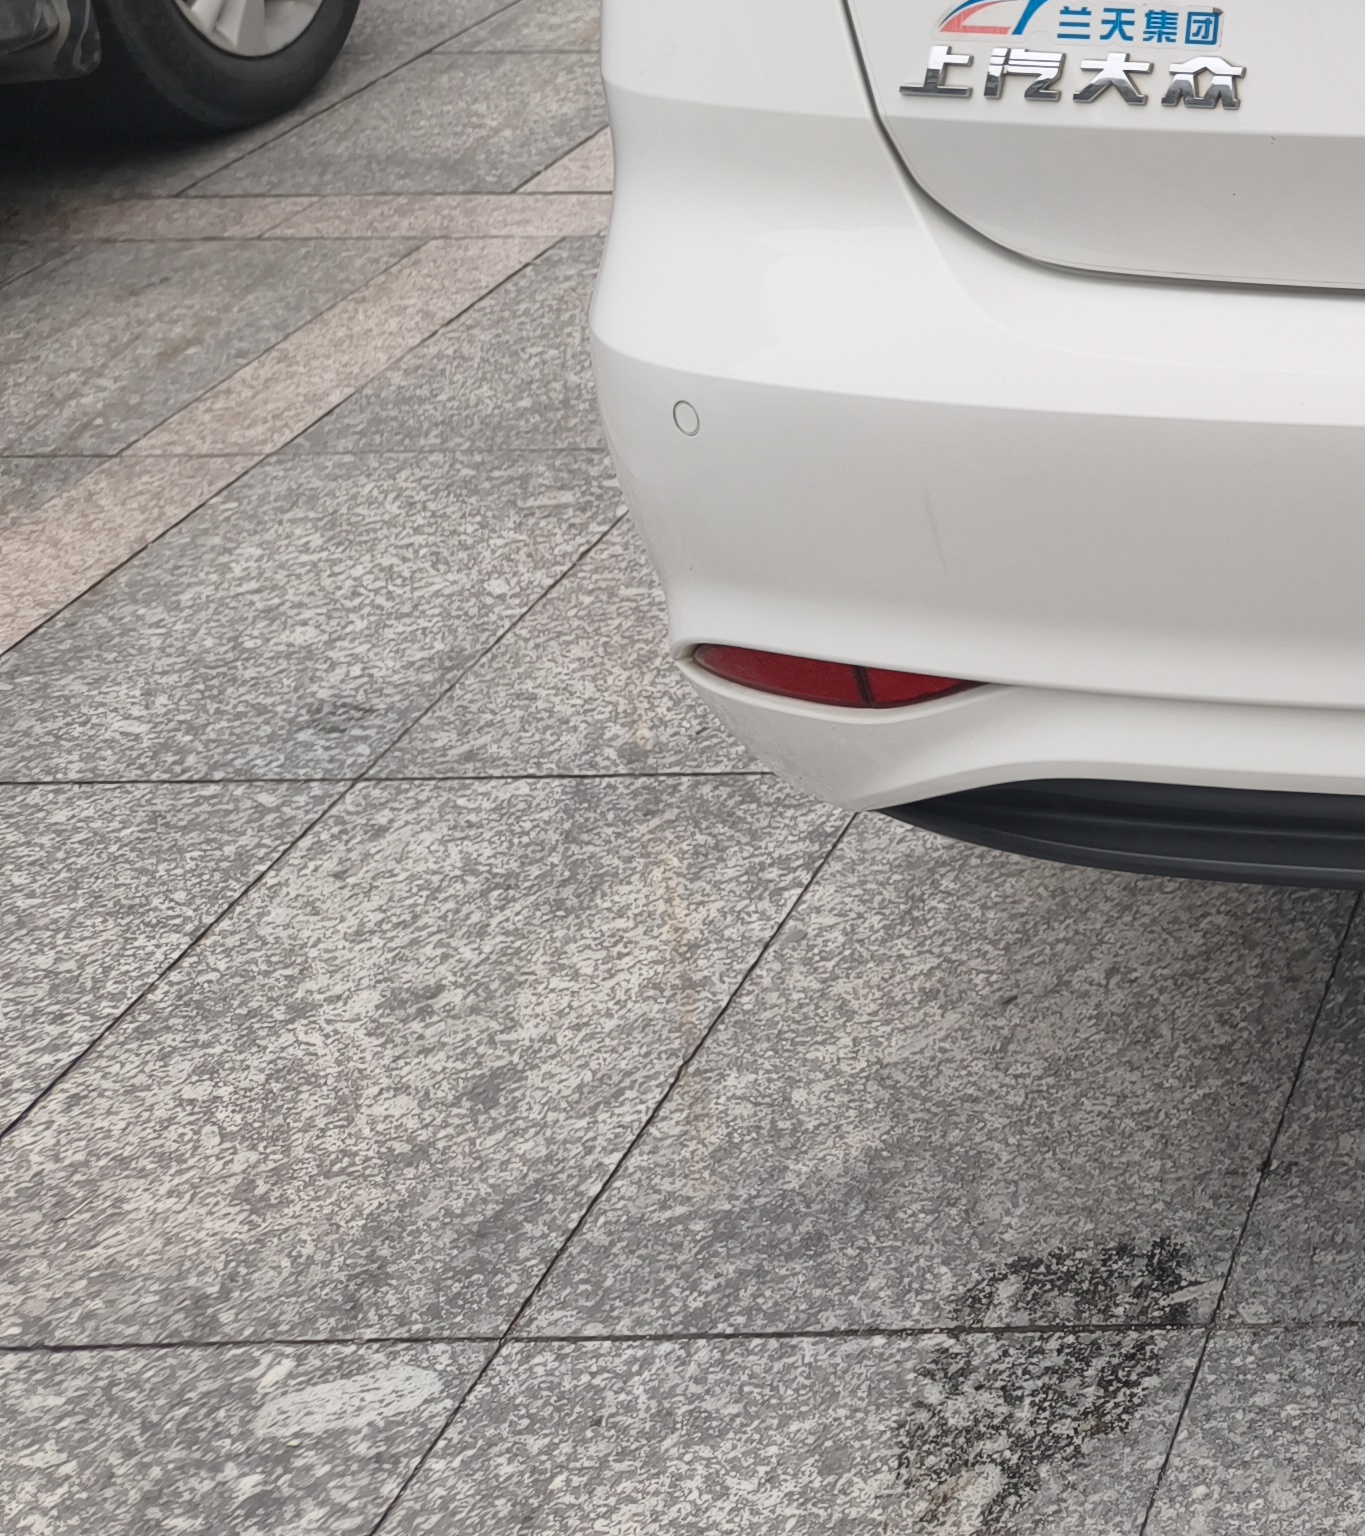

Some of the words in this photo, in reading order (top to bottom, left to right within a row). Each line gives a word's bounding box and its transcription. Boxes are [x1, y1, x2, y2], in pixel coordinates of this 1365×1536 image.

[1056, 5, 1220, 46] 兰天集团
[899, 45, 1247, 110] 上汽大众
